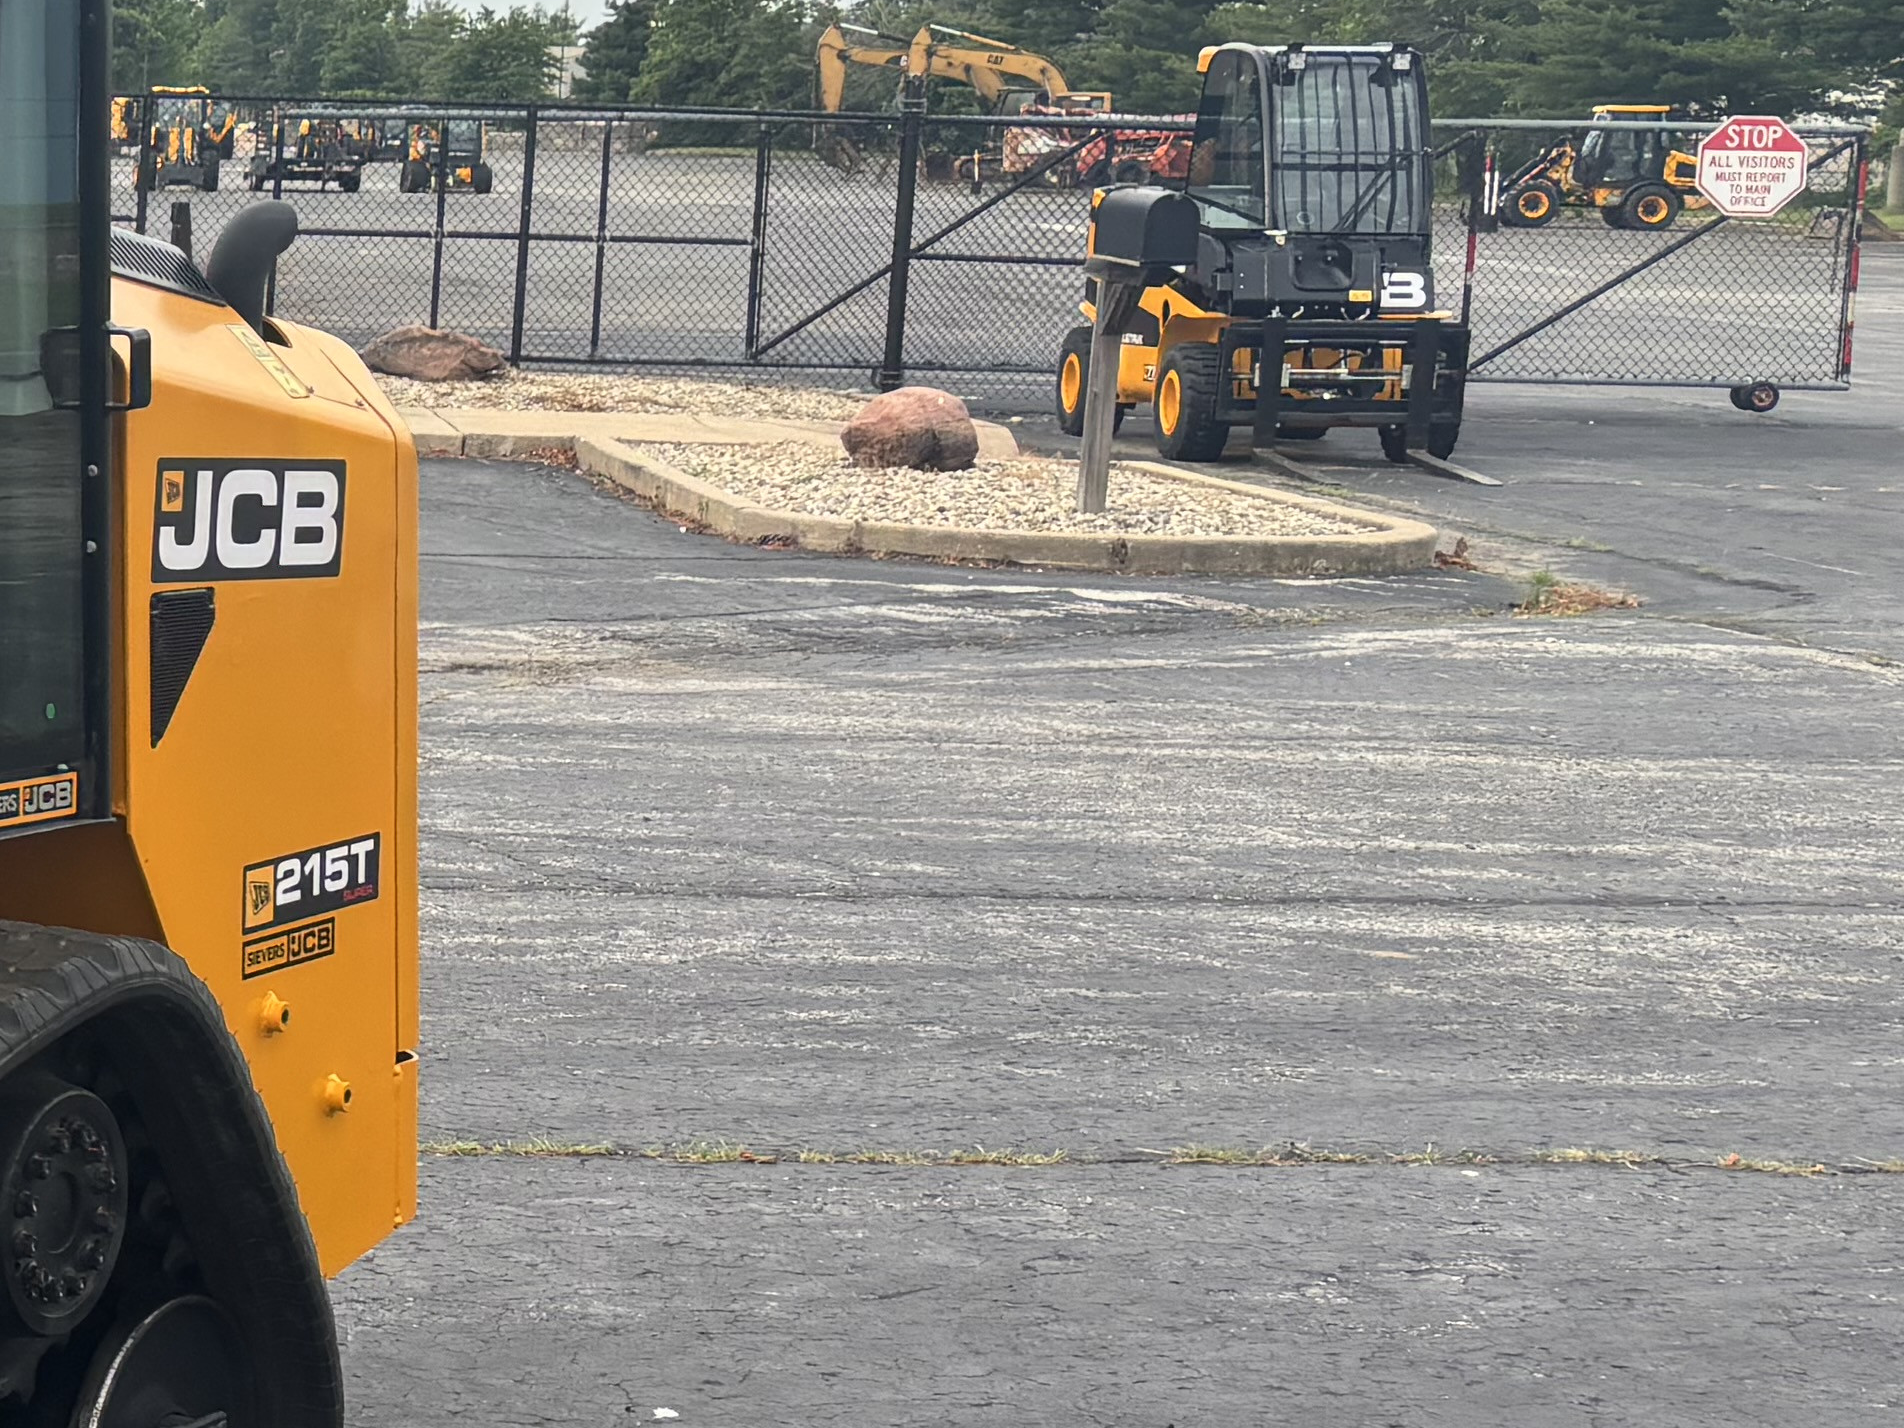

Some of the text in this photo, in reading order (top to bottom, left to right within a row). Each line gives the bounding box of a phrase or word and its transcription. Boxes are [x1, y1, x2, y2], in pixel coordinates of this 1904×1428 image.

[1725, 124, 1783, 148] STOP
[1709, 155, 1795, 170] ALL VISITORS
[1715, 171, 1786, 184] MUST REPORT
[1729, 183, 1771, 195] TO MAIN
[1729, 195, 1768, 207] OFFICE
[158, 469, 339, 571] JCB
[24, 780, 72, 814] JCB
[275, 838, 375, 906] 215T
[246, 926, 331, 967] SIEVERS JCB
